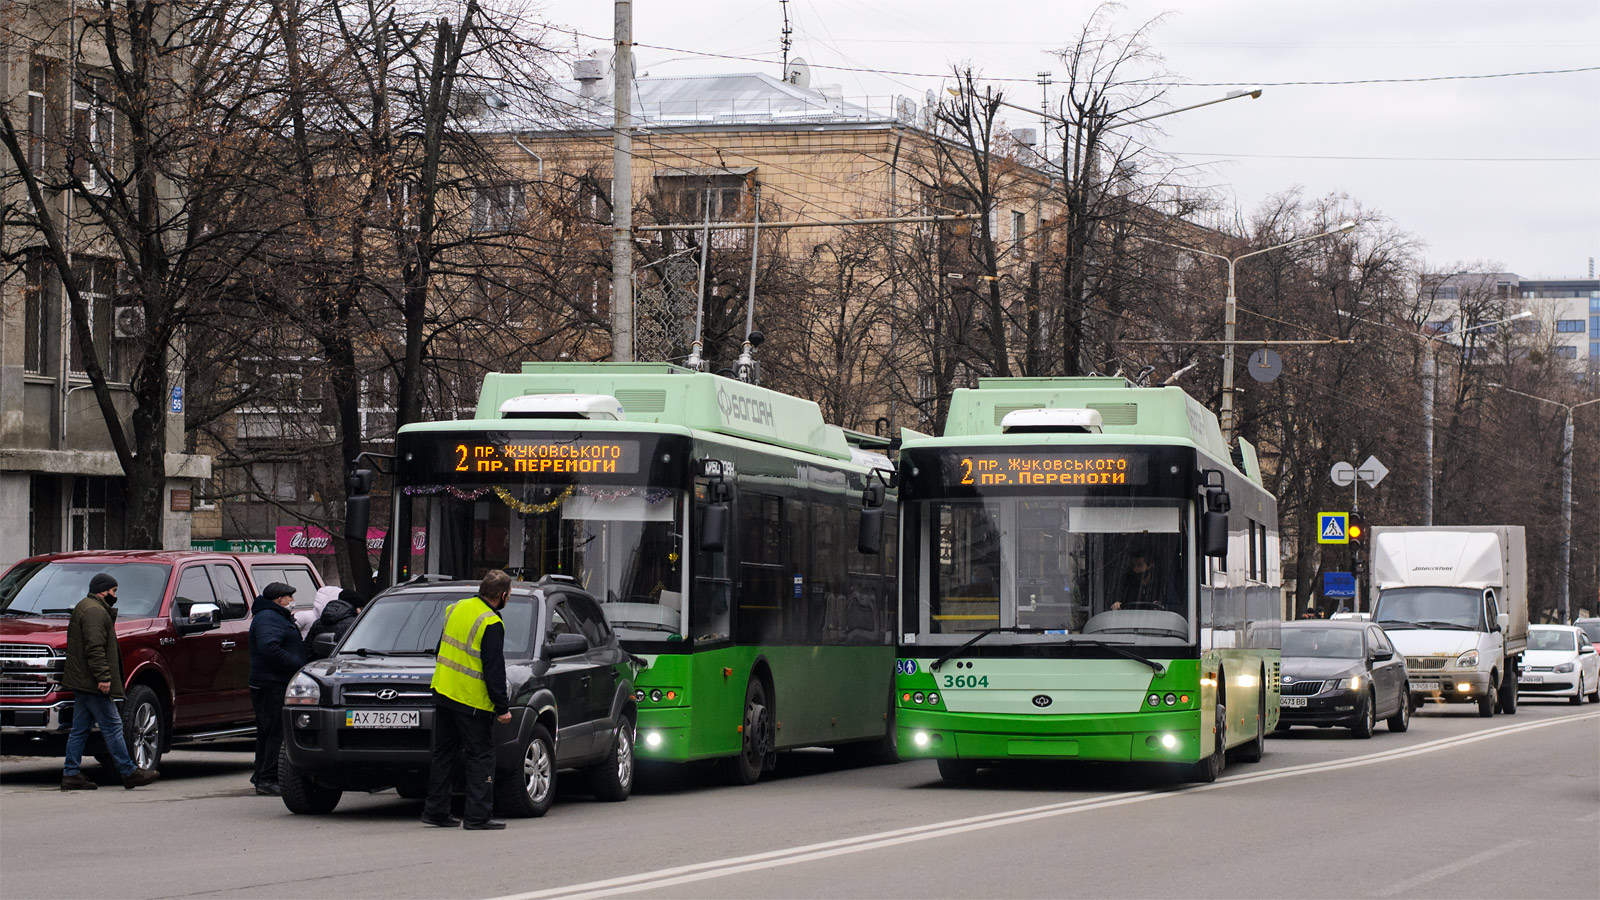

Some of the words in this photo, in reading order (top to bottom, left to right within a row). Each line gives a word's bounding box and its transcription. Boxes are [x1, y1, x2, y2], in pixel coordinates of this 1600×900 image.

[731, 394, 774, 427] БОГДАН
[455, 444, 469, 472] 2
[504, 445, 621, 458] ЖУКОВСЬКОГО
[514, 459, 616, 472] ПЕРЕМОГИ
[960, 458, 974, 484] 2
[943, 674, 989, 688] 3604
[353, 712, 370, 724] AX
[372, 712, 398, 724] 7867
[400, 712, 417, 724] CM
